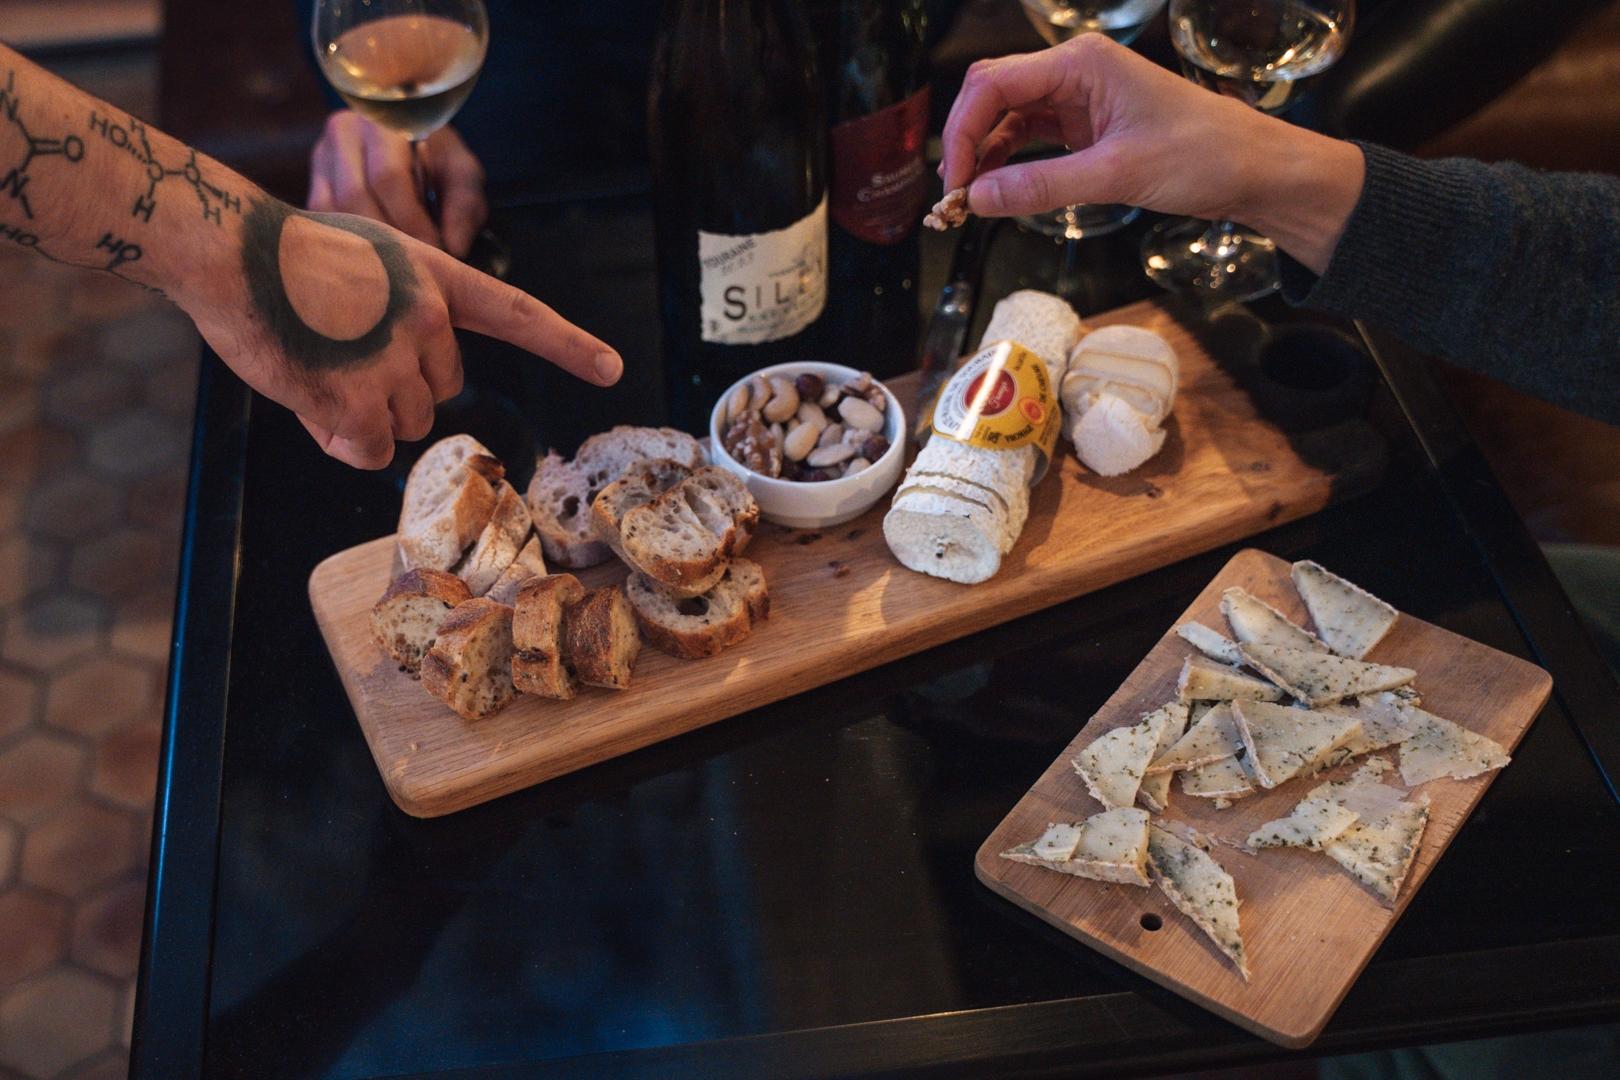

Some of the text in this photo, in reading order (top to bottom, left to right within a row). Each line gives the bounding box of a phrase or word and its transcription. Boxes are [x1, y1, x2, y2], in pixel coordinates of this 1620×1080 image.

[90, 111, 128, 148] HO
[64, 134, 85, 163] O
[132, 195, 156, 223] H
